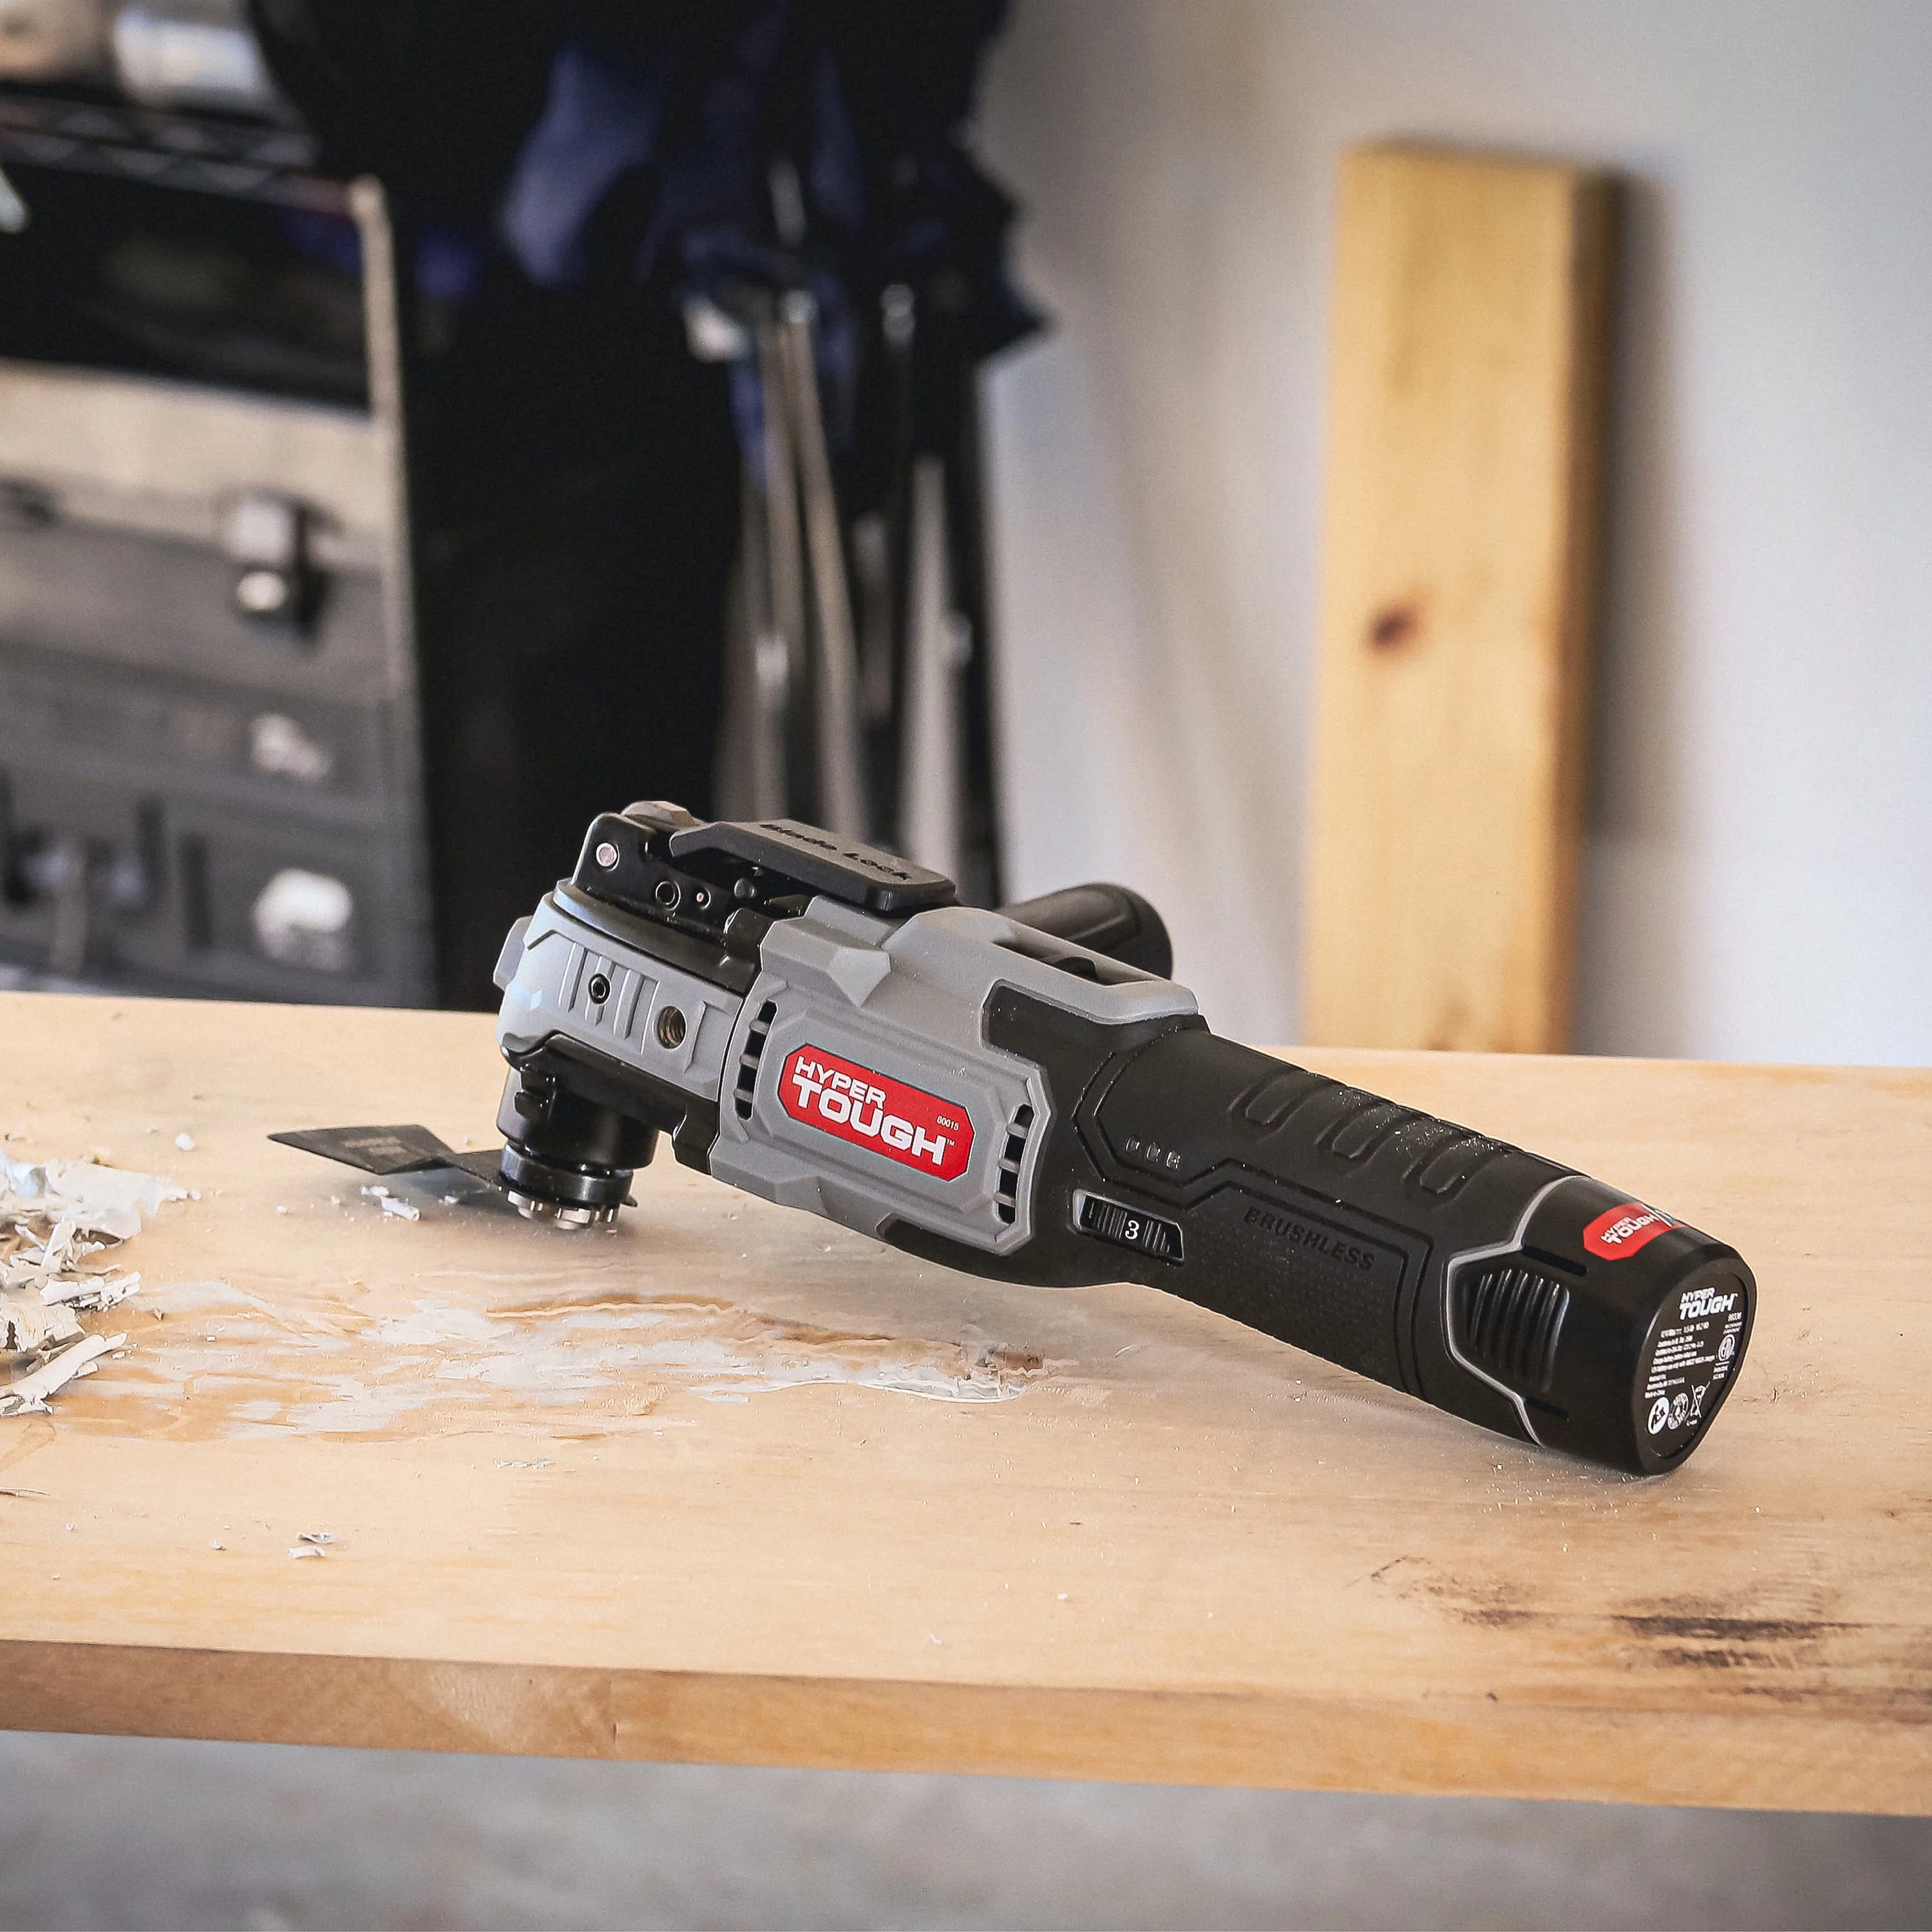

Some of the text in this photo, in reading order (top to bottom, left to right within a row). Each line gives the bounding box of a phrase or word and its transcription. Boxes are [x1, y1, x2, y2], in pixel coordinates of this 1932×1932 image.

[795, 1056, 887, 1109] HYPER
[791, 1073, 947, 1166] TOUGH
[1125, 1220, 1139, 1240] 3
[1244, 1206, 1375, 1270] BRUSHLESS
[1609, 1213, 1660, 1244] TOUGH
[1679, 1293, 1735, 1320] TOUGH
[1681, 1287, 1715, 1303] HYPER
